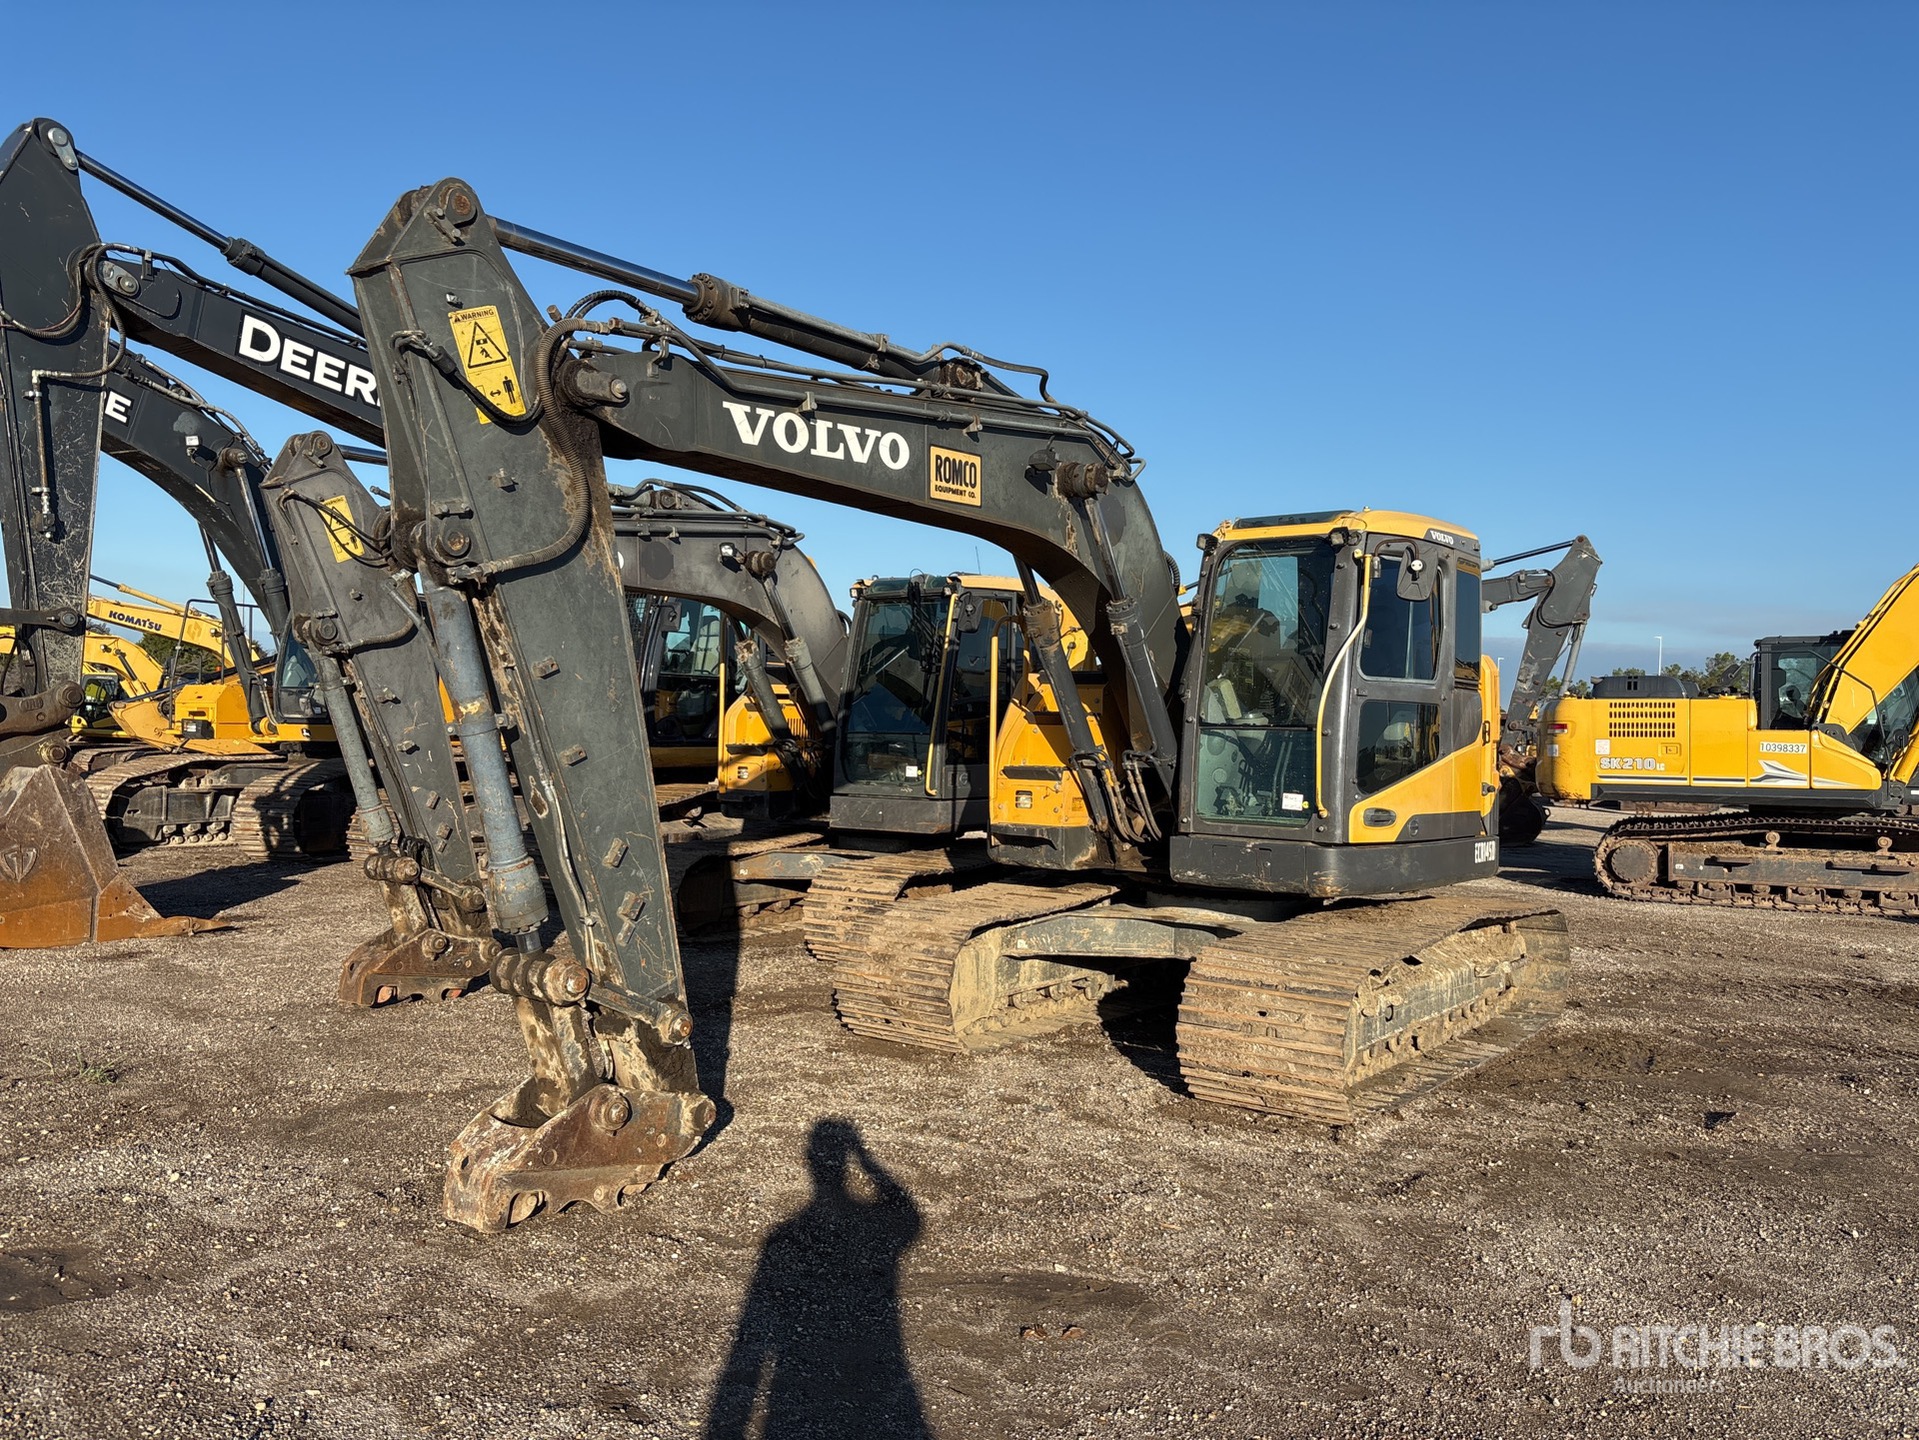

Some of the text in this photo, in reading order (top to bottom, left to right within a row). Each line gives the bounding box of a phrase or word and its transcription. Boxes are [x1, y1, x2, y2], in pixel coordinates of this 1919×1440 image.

[460, 309, 495, 321] WARNING
[238, 314, 381, 407] DEER
[722, 400, 910, 470] VOLVO
[935, 454, 977, 489] ROMCO
[934, 484, 967, 497] EQUIPMENT
[1430, 530, 1454, 545] VOLVO
[108, 610, 162, 632] KOMATSU
[1760, 742, 1806, 753] 10398337
[1600, 757, 1656, 770] SK210
